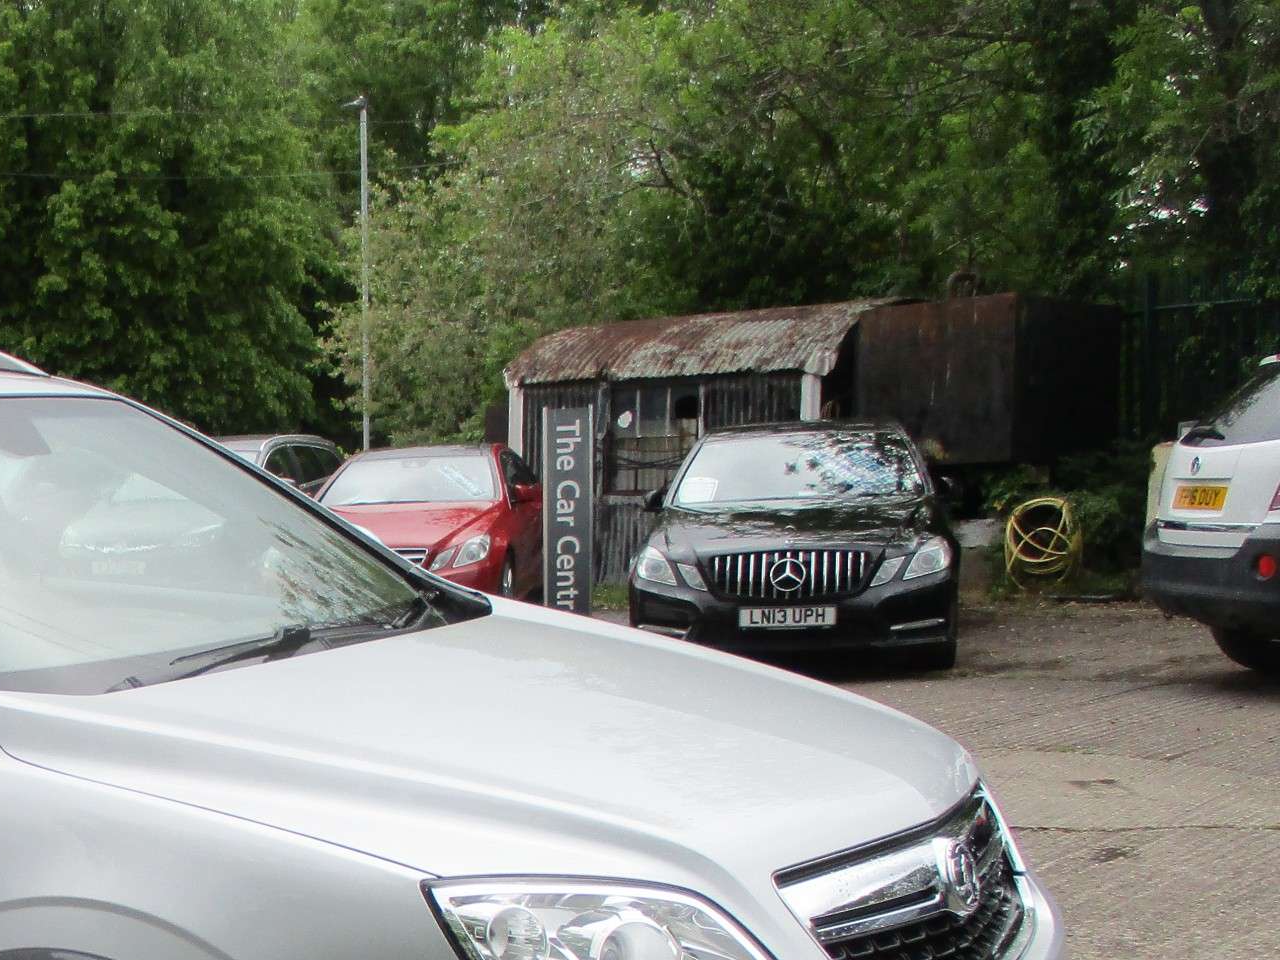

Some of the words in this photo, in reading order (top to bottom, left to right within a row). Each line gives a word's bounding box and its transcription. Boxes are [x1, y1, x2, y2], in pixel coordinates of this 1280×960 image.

[556, 419, 582, 471] The
[556, 480, 581, 527] Car
[749, 608, 787, 624] LN13
[792, 606, 826, 623] UPH
